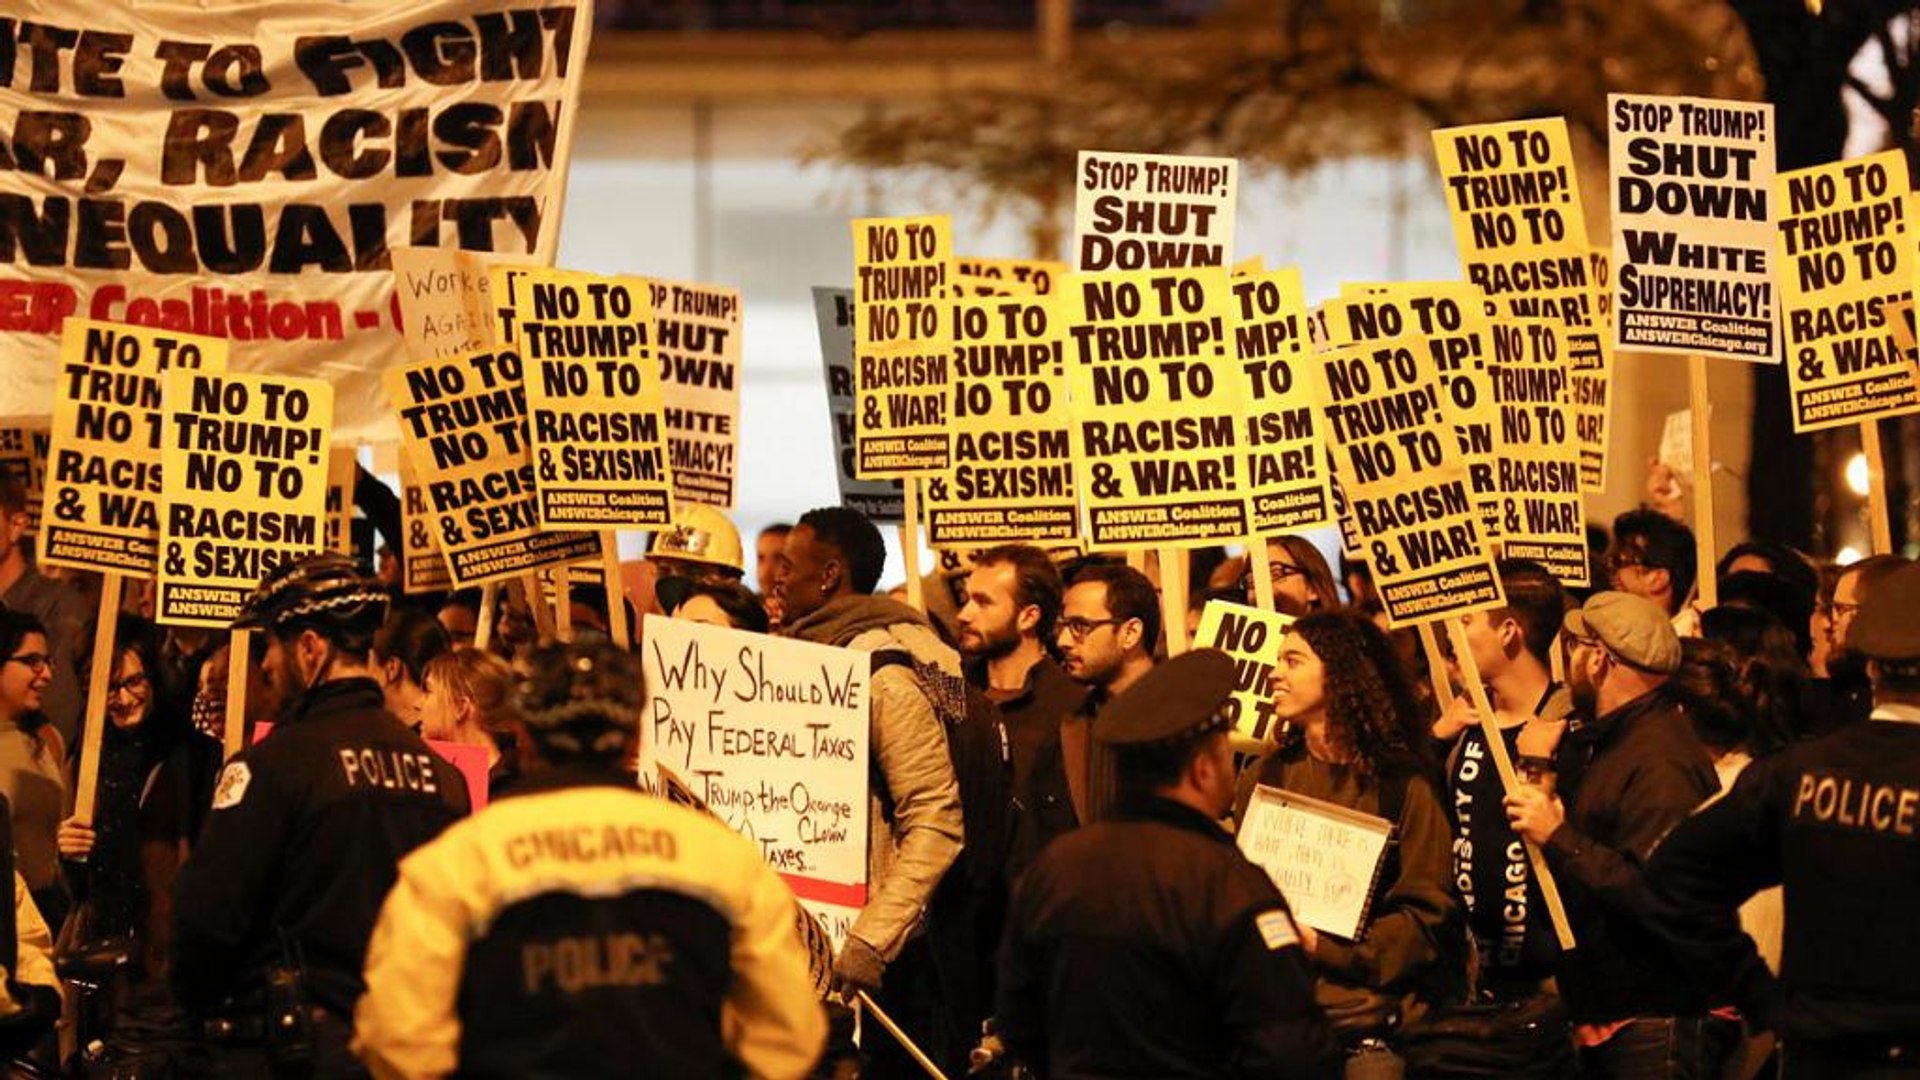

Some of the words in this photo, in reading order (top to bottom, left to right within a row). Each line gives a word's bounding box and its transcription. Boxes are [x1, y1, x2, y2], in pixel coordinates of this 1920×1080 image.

[155, 40, 271, 100] TO
[294, 6, 576, 97] FIGHT
[1614, 99, 1673, 133] STOP
[1679, 101, 1766, 143] TRUMP!
[1454, 134, 1502, 173] NO
[1507, 129, 1551, 168] TO
[1627, 137, 1757, 181] SHUT
[1084, 157, 1139, 191] STOP
[1144, 161, 1229, 198] TRUMP!
[1449, 165, 1571, 212] TRUMP!
[1788, 174, 1836, 216] NO
[1843, 162, 1888, 203] TO
[1092, 194, 1218, 237] SHUT
[1618, 176, 1768, 222] DOWN
[868, 225, 899, 264] NO
[905, 224, 937, 261] TO
[1470, 212, 1517, 250] NO
[1521, 207, 1566, 245] TO
[1777, 196, 1905, 256] TRUMP!
[1080, 234, 1224, 271] DOWN
[1622, 229, 1767, 275] WHITE
[1797, 251, 1846, 293] NO
[1852, 241, 1898, 282] TO
[858, 261, 946, 303] TRUMP!
[1468, 256, 1588, 296] RACISM
[1619, 263, 1772, 319] SUPREMACY!
[90, 284, 344, 341] Coalition
[532, 283, 580, 321] NO
[587, 283, 632, 321] TO
[672, 286, 737, 322] TRUMP!
[1082, 280, 1141, 323] NO
[1150, 276, 1205, 318] TO
[1232, 280, 1281, 321] TO
[1346, 302, 1403, 341] NO
[1410, 297, 1462, 335] TO
[522, 321, 650, 360] TRUMP!
[655, 318, 729, 355] HUT
[868, 304, 899, 342] NO
[905, 302, 938, 341] TO
[998, 304, 1048, 340] TO
[1069, 315, 1226, 365] TRUMP!
[1234, 314, 1302, 361] MP!
[1625, 313, 1698, 332] ANSWER
[1701, 319, 1768, 338] Coalition
[84, 328, 140, 366] NO
[152, 338, 202, 371] TO
[954, 341, 1065, 377] RUMP!
[1492, 323, 1524, 364] NO
[1528, 324, 1558, 365] TO
[1797, 347, 1826, 383] &
[405, 365, 464, 404] NO
[469, 351, 524, 389] TO
[541, 361, 588, 398] NO
[596, 361, 641, 398] TO
[860, 354, 948, 391] RACISM
[1092, 364, 1150, 407] NO
[1159, 361, 1214, 402] TO
[1243, 359, 1293, 401] TO
[1324, 358, 1371, 402] NO
[1372, 347, 1418, 391] TO
[1487, 364, 1570, 405] TRUMP!
[191, 376, 248, 415] NO
[260, 383, 309, 423] TO
[862, 395, 883, 431] &
[887, 391, 947, 429] WAR!
[1002, 380, 1052, 417] TO
[1323, 383, 1444, 445] TRUMP!
[1801, 383, 1863, 406] ANSWER
[76, 402, 132, 443] NO
[173, 412, 322, 465] TRUMP!
[534, 408, 660, 445] RACISM
[664, 406, 731, 436] HITE
[1082, 415, 1236, 458] RACISM
[1246, 406, 1315, 446] ISM
[1501, 405, 1531, 446] NO
[1534, 405, 1566, 445] TO
[429, 431, 488, 471] NO
[538, 446, 558, 482] &
[561, 444, 666, 484] SEXISM!
[956, 429, 1070, 463] ACISM
[1347, 440, 1397, 485] NO
[1397, 431, 1443, 473] TO
[56, 449, 162, 494] RACIS
[185, 452, 242, 493] NO
[255, 459, 304, 500] TO
[429, 464, 535, 513] RACIS
[928, 477, 950, 502] &
[956, 462, 1074, 501] SEXISM!
[1090, 461, 1124, 499] &
[1130, 455, 1237, 497] WAR!
[1498, 456, 1579, 495] RACISM
[54, 487, 85, 523] &
[99, 492, 160, 531] WA
[546, 492, 606, 508] ANSWER
[608, 492, 665, 507] Coalition
[935, 511, 1004, 525] ANSWER
[1007, 509, 1072, 524] Coalition
[1096, 506, 1168, 526] ANSWER
[1170, 503, 1241, 522] Coalition
[1260, 490, 1322, 513] Coalition
[1353, 480, 1471, 538] RACISM
[1503, 497, 1522, 535] &
[1524, 498, 1580, 536] WAR!
[52, 530, 125, 552] ANSWER
[168, 502, 316, 545] RACISM
[440, 515, 466, 547] &
[164, 541, 186, 577] &
[457, 541, 527, 567] ANSWER
[1370, 540, 1401, 577] &
[1397, 519, 1482, 571] WAR!
[168, 586, 242, 604] ANSWER
[1386, 582, 1439, 602] ANSWER
[1439, 569, 1490, 592] Coalition
[1213, 612, 1267, 654] NO
[652, 638, 727, 702] Why
[822, 664, 862, 710] WE
[708, 709, 806, 760] FEDERAL
[340, 749, 437, 794] POLICE
[1458, 741, 1485, 782] OF
[757, 779, 789, 814] the
[1793, 772, 1920, 835] POLICE
[504, 823, 678, 872] CHICAGO
